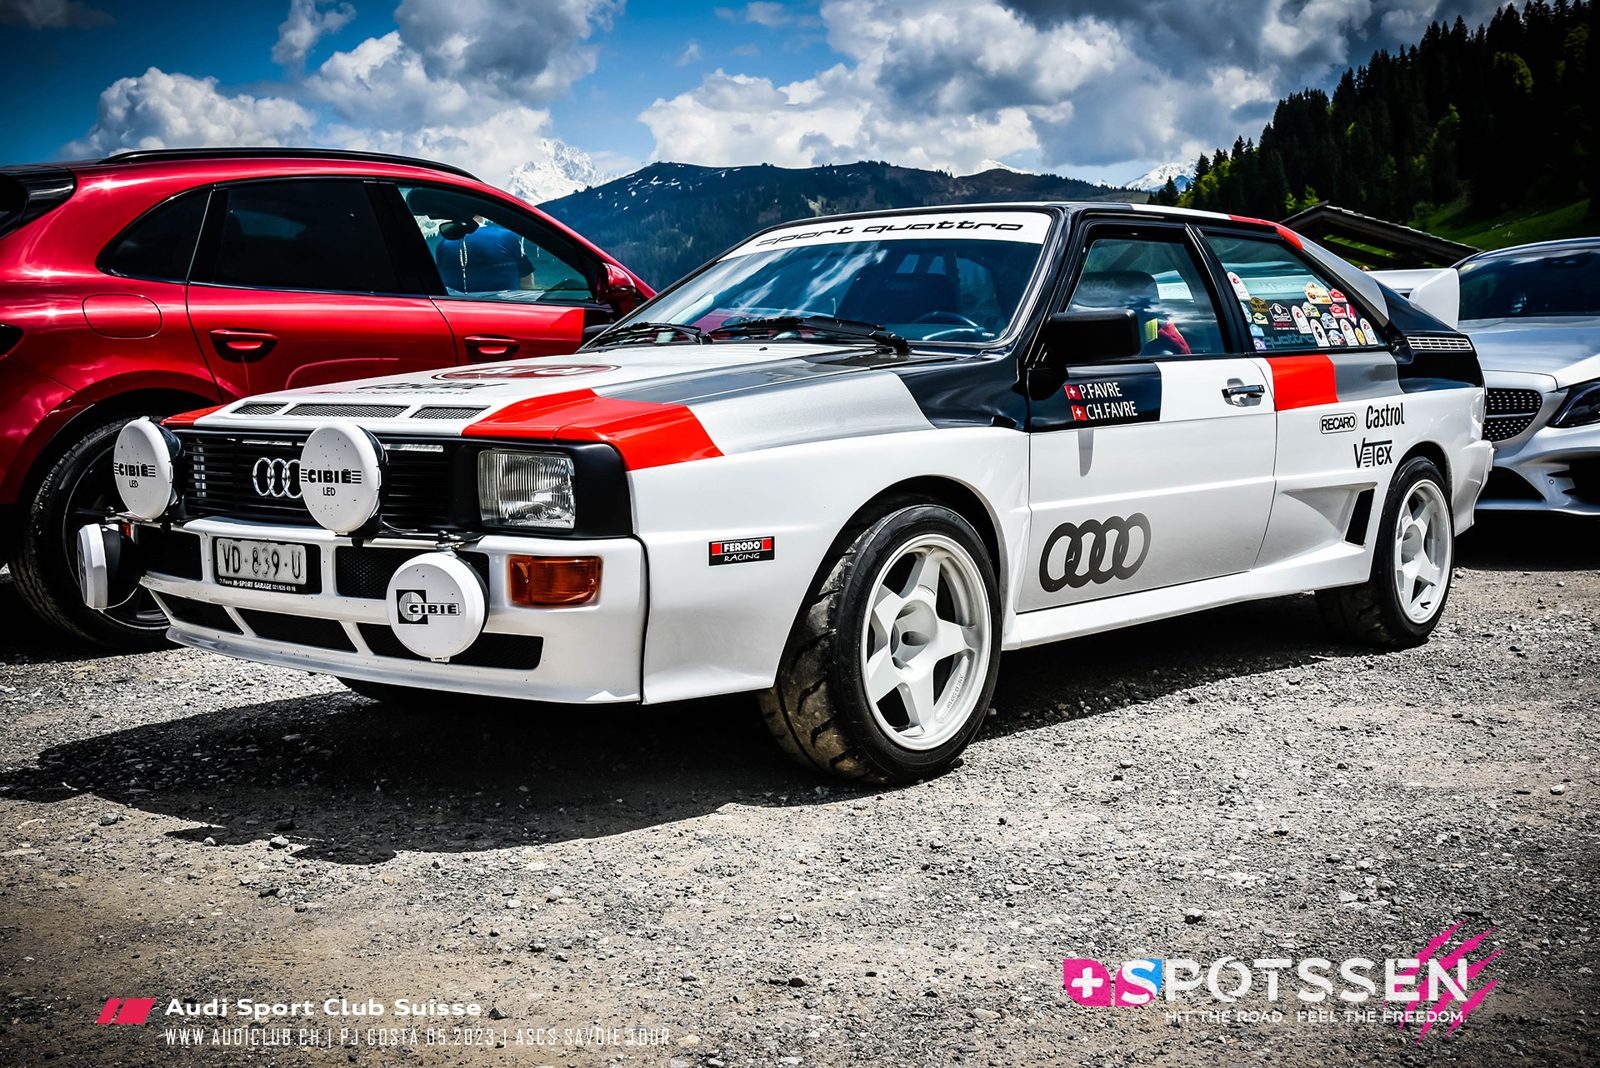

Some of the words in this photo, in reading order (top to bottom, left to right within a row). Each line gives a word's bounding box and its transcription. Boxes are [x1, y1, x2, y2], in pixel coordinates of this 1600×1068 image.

[755, 226, 854, 247] sport
[862, 220, 1024, 234] quattro
[1079, 382, 1123, 399] P.FAVRE
[1086, 401, 1139, 420] CH.FAVRE
[1365, 402, 1405, 430] Castrol
[1321, 415, 1356, 431] RECARO
[129, 480, 139, 488] LED
[323, 487, 336, 496] LED
[723, 541, 760, 553] FERODO
[723, 553, 760, 562] RACING
